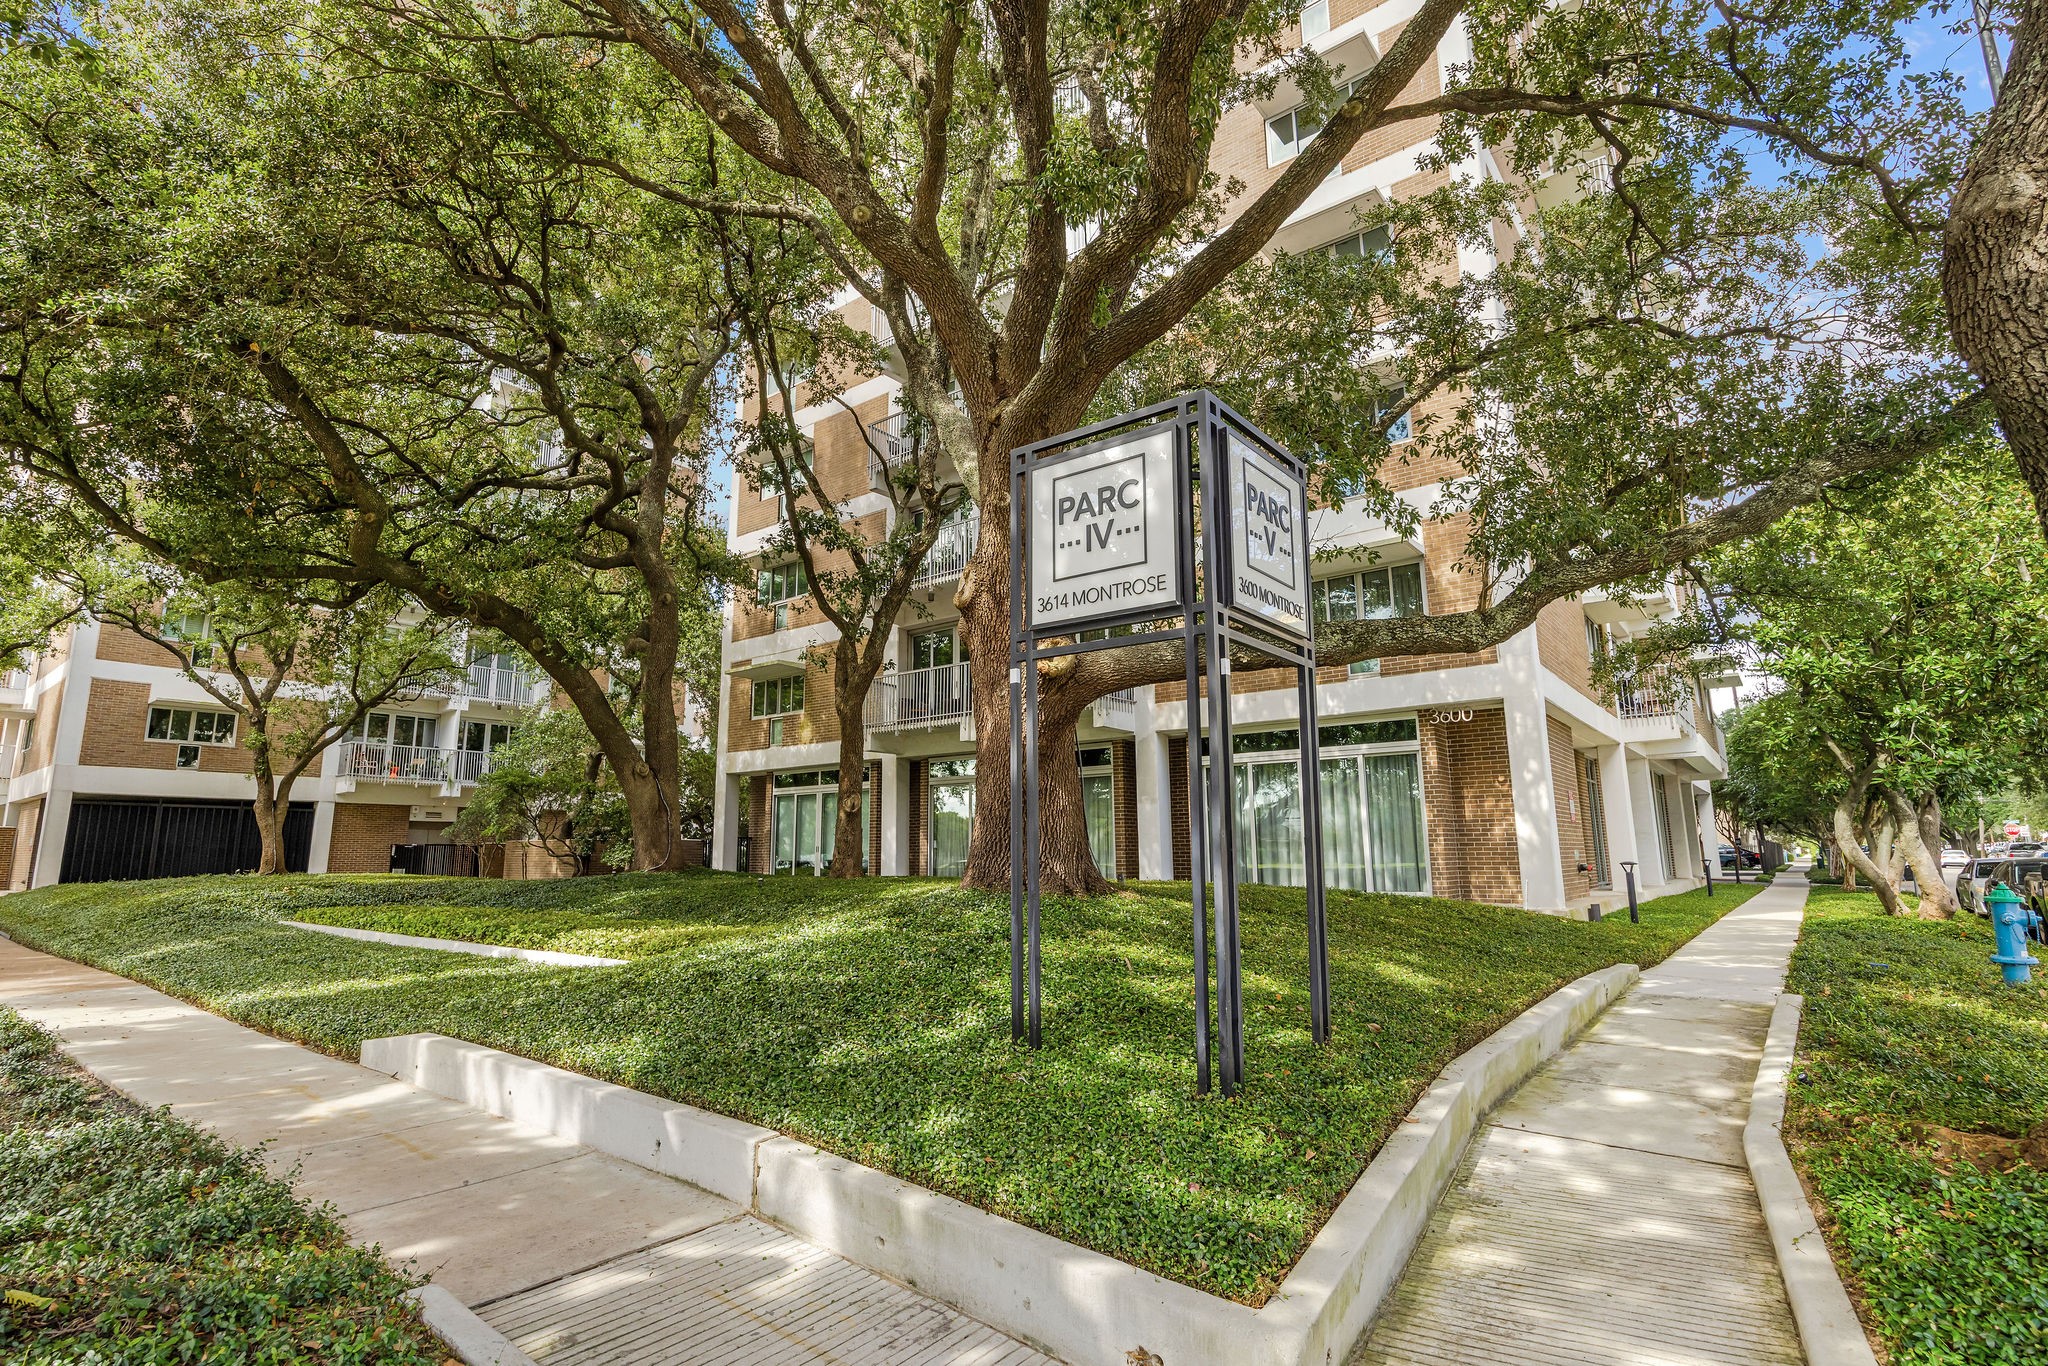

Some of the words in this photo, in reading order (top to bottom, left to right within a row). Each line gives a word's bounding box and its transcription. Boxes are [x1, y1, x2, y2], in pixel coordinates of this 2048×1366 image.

[1058, 478, 1140, 525] PARC
[1247, 482, 1290, 534] PARC
[1086, 518, 1115, 552] IV
[1264, 525, 1276, 556] V
[1037, 596, 1069, 613] 3614
[1072, 574, 1167, 606] MONTROSE
[1238, 576, 1258, 599] 3600
[1259, 585, 1304, 621] MONTROSE
[1429, 707, 1473, 724] 3600
